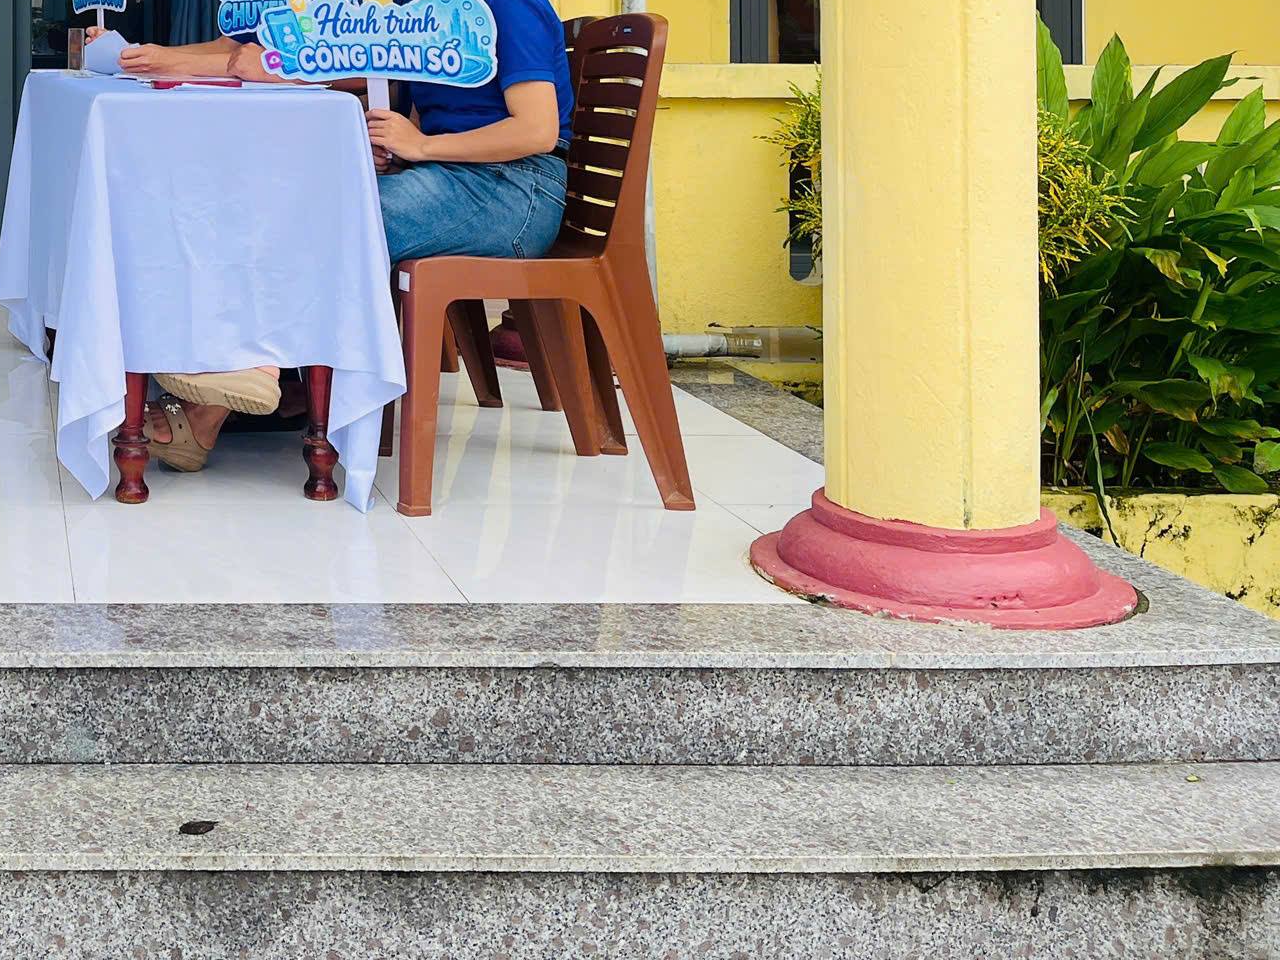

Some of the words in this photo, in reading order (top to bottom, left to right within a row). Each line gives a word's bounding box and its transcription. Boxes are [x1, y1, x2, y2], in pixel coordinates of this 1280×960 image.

[314, 2, 381, 38] Hành
[384, 5, 440, 35] trình
[298, 40, 368, 75] CÔNG
[370, 39, 423, 73] DÂN
[425, 38, 462, 77] SỐ
